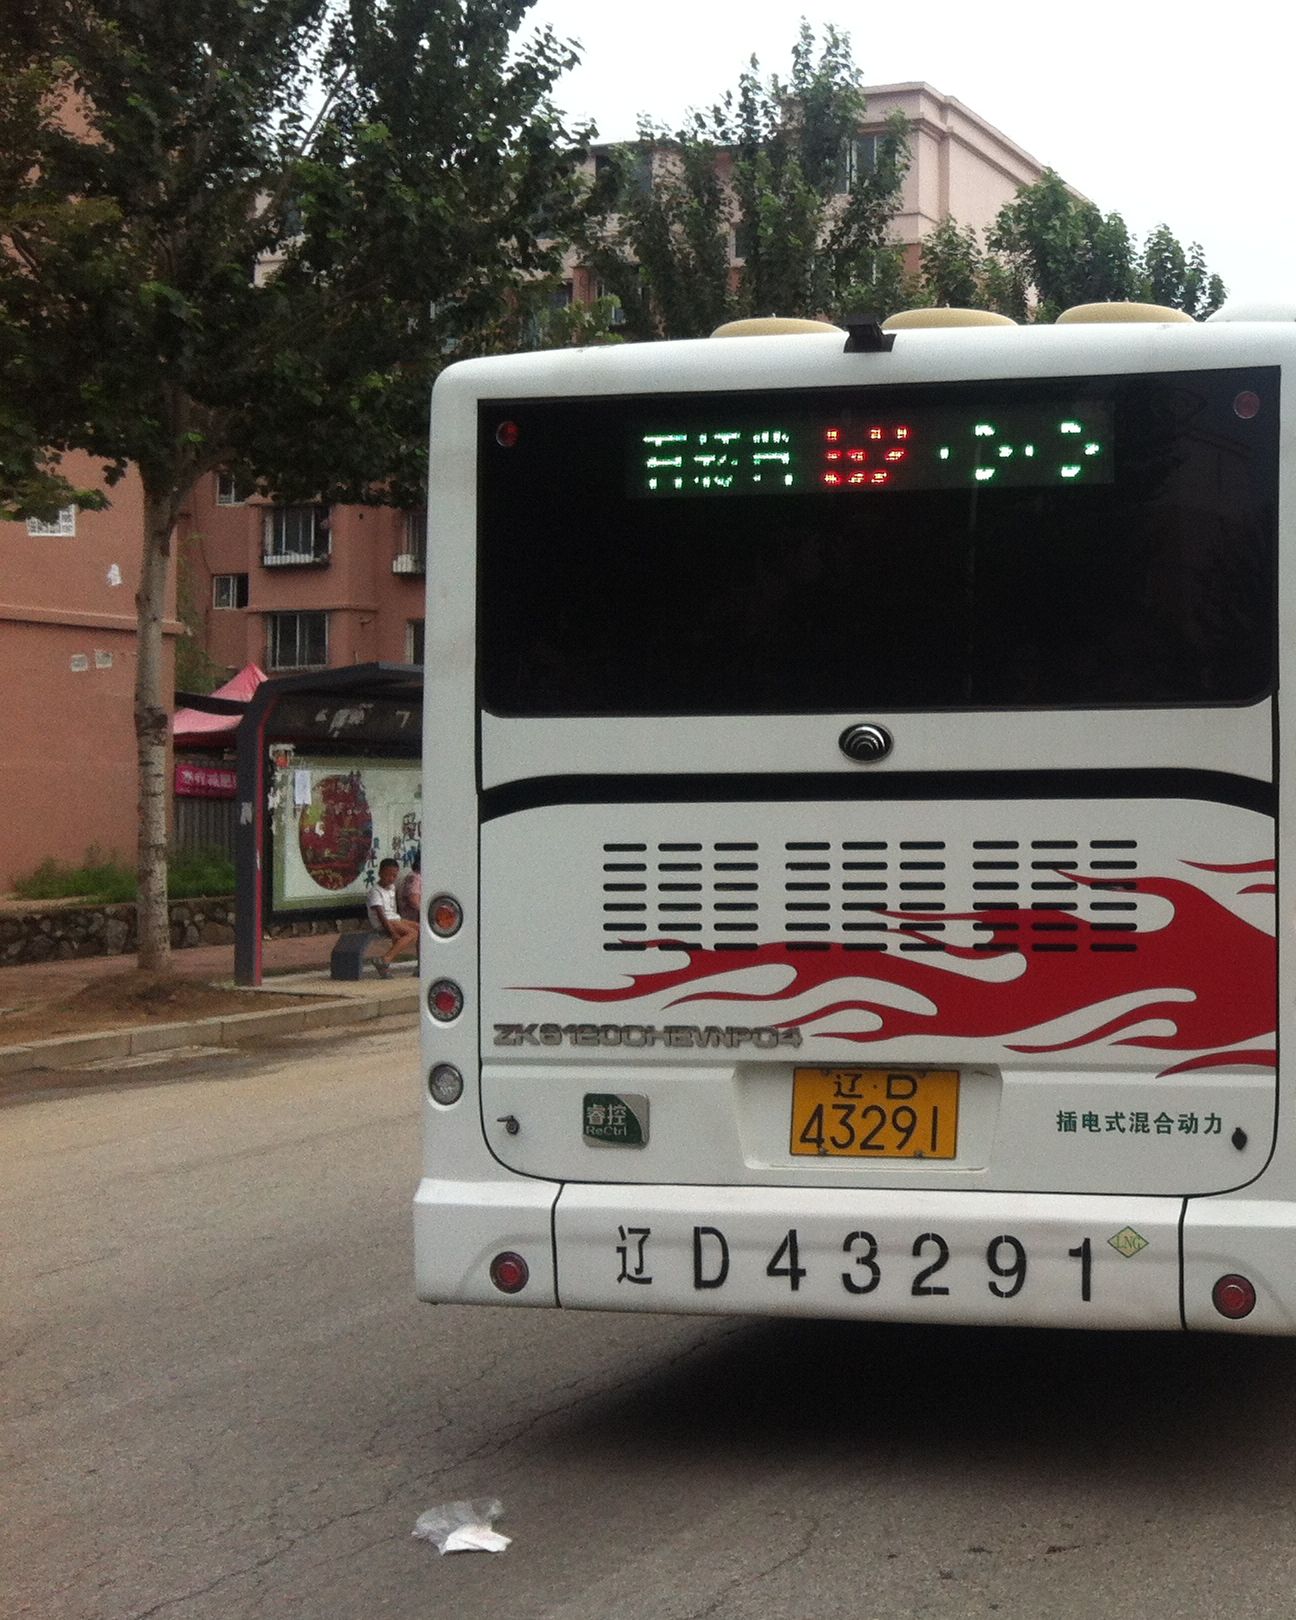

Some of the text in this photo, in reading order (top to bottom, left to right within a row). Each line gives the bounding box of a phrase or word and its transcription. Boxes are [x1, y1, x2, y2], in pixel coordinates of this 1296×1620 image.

[586, 1104, 627, 1126] 睿控
[1056, 1109, 1222, 1135] 插电式混合动力
[585, 1125, 627, 1136] ReCtrl
[800, 1103, 938, 1152] 43291
[1115, 1234, 1142, 1250] LNG
